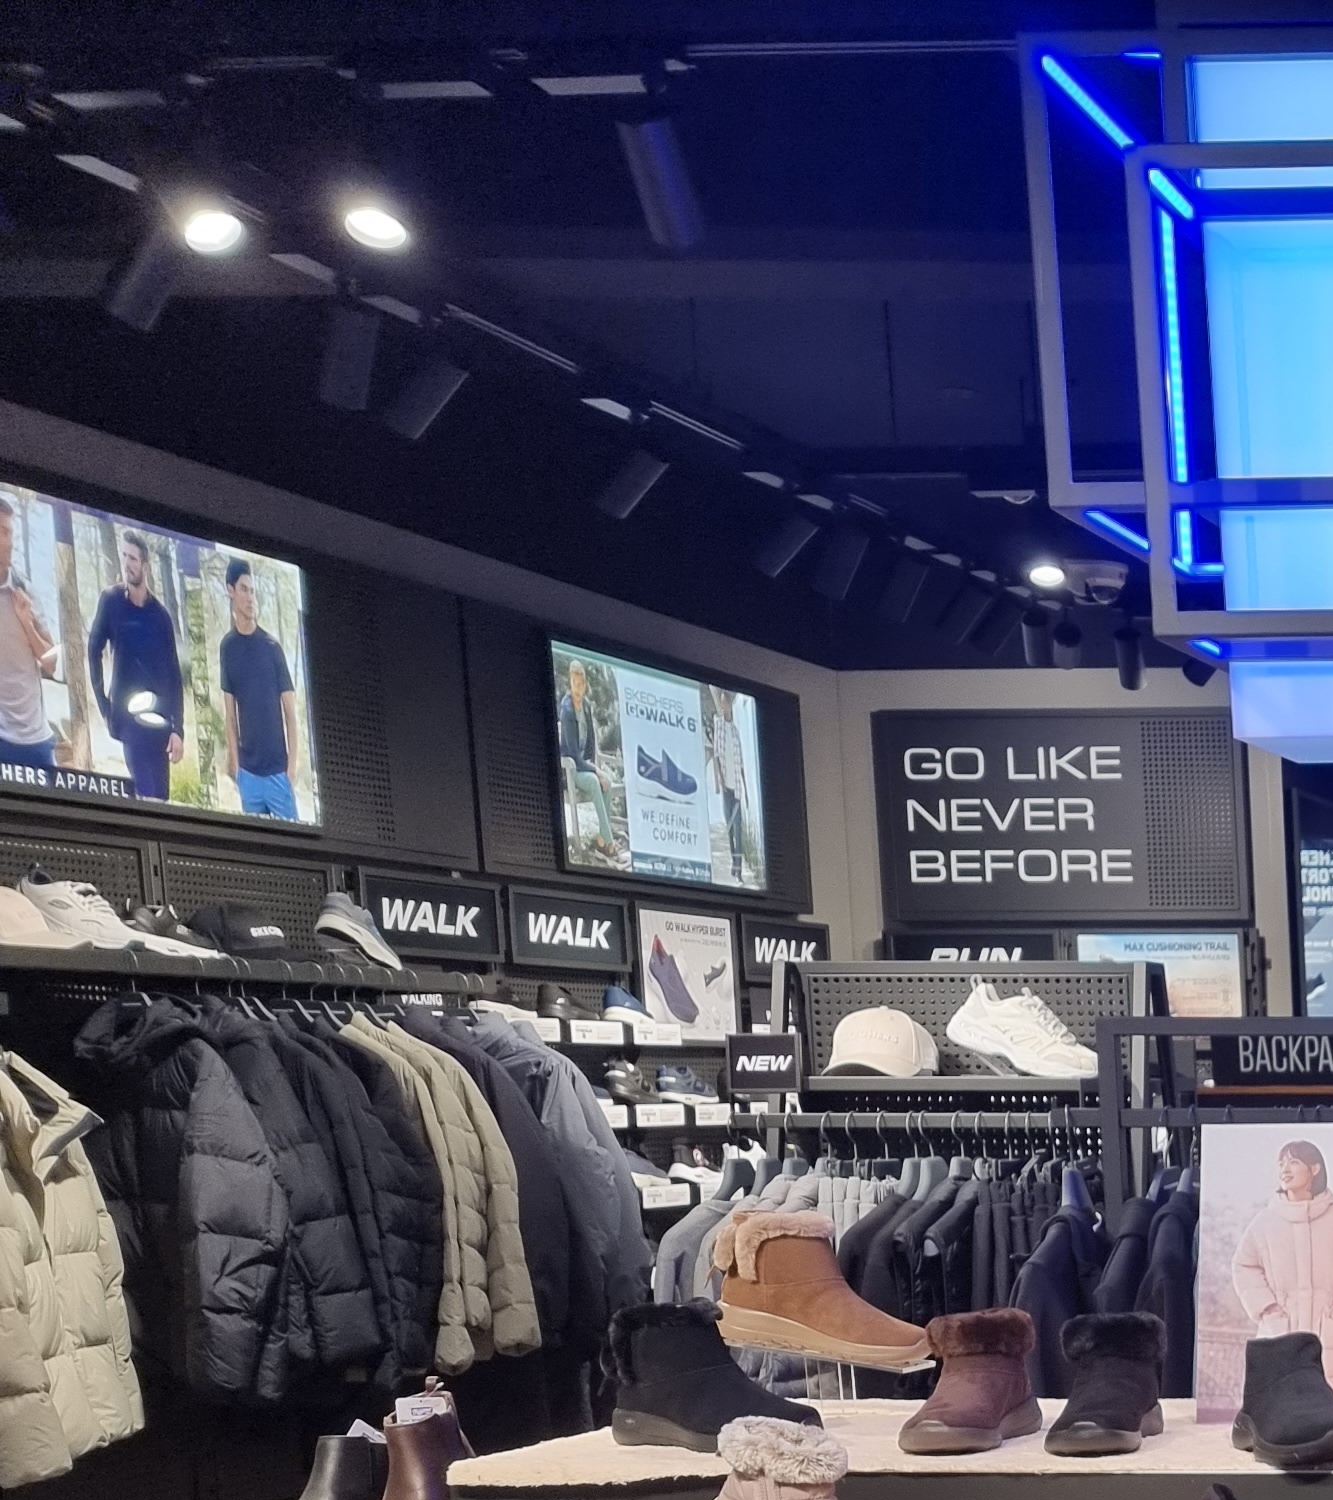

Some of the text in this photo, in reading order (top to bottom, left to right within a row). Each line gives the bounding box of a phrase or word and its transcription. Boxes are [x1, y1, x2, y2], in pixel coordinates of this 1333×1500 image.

[624, 687, 684, 713] SKECHERS
[687, 717, 697, 733] 6
[903, 746, 1122, 781] GO LIKE
[0, 763, 129, 798] HERS APPAREL
[641, 809, 690, 829] WE DEFINE
[906, 798, 1095, 832] NEVER
[652, 827, 698, 846] COMFORT
[910, 849, 1133, 883] BEFORE
[381, 897, 481, 938] WALK
[528, 912, 612, 949] WALK
[754, 936, 817, 963] WALK
[1124, 942, 1230, 952] MAX CUSHIONING TRAIL
[736, 1054, 793, 1072] NEW
